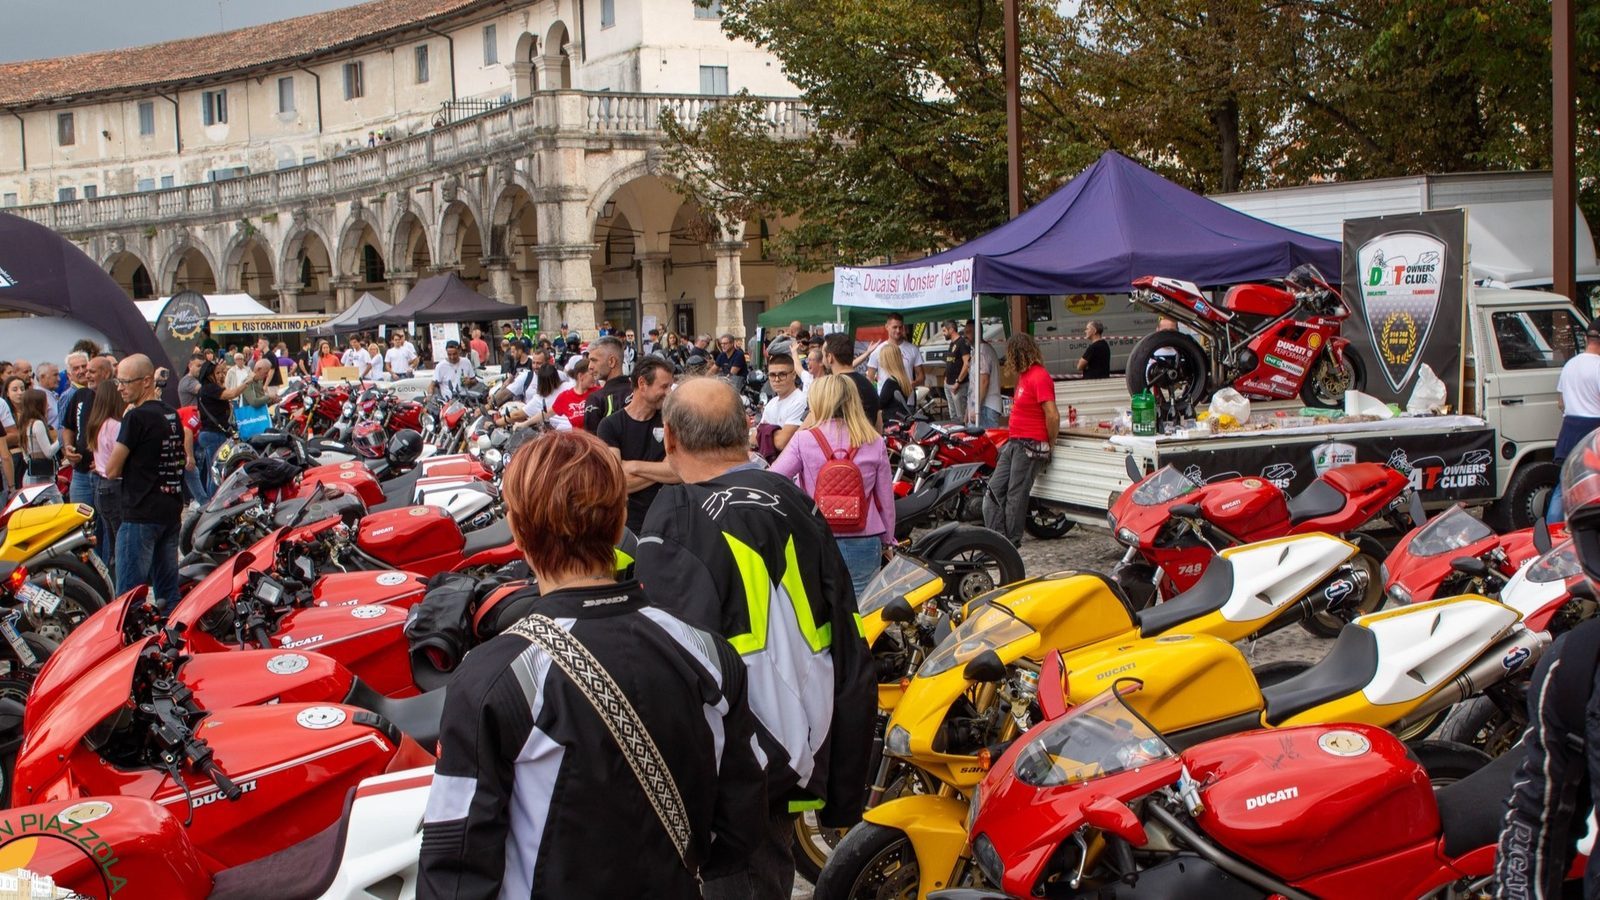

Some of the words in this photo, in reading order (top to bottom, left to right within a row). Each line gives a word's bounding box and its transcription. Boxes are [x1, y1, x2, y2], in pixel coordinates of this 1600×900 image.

[1406, 264, 1435, 273] OWNERS
[902, 272, 939, 291] Monster
[941, 265, 970, 287] Veneto
[1405, 274, 1428, 285] CLUB
[232, 322, 240, 331] IL
[242, 320, 301, 332] RISTORANTINO
[1276, 340, 1306, 355] DUCATI
[1443, 463, 1487, 476] OWNERS
[1440, 474, 1477, 489] CLUB
[1221, 499, 1241, 511] DUCATI
[372, 526, 394, 537] DUCATI
[1178, 563, 1202, 575] 748
[1096, 661, 1137, 681] DUCATI
[192, 780, 257, 809] DUCTI
[1245, 786, 1299, 811] DUCATI
